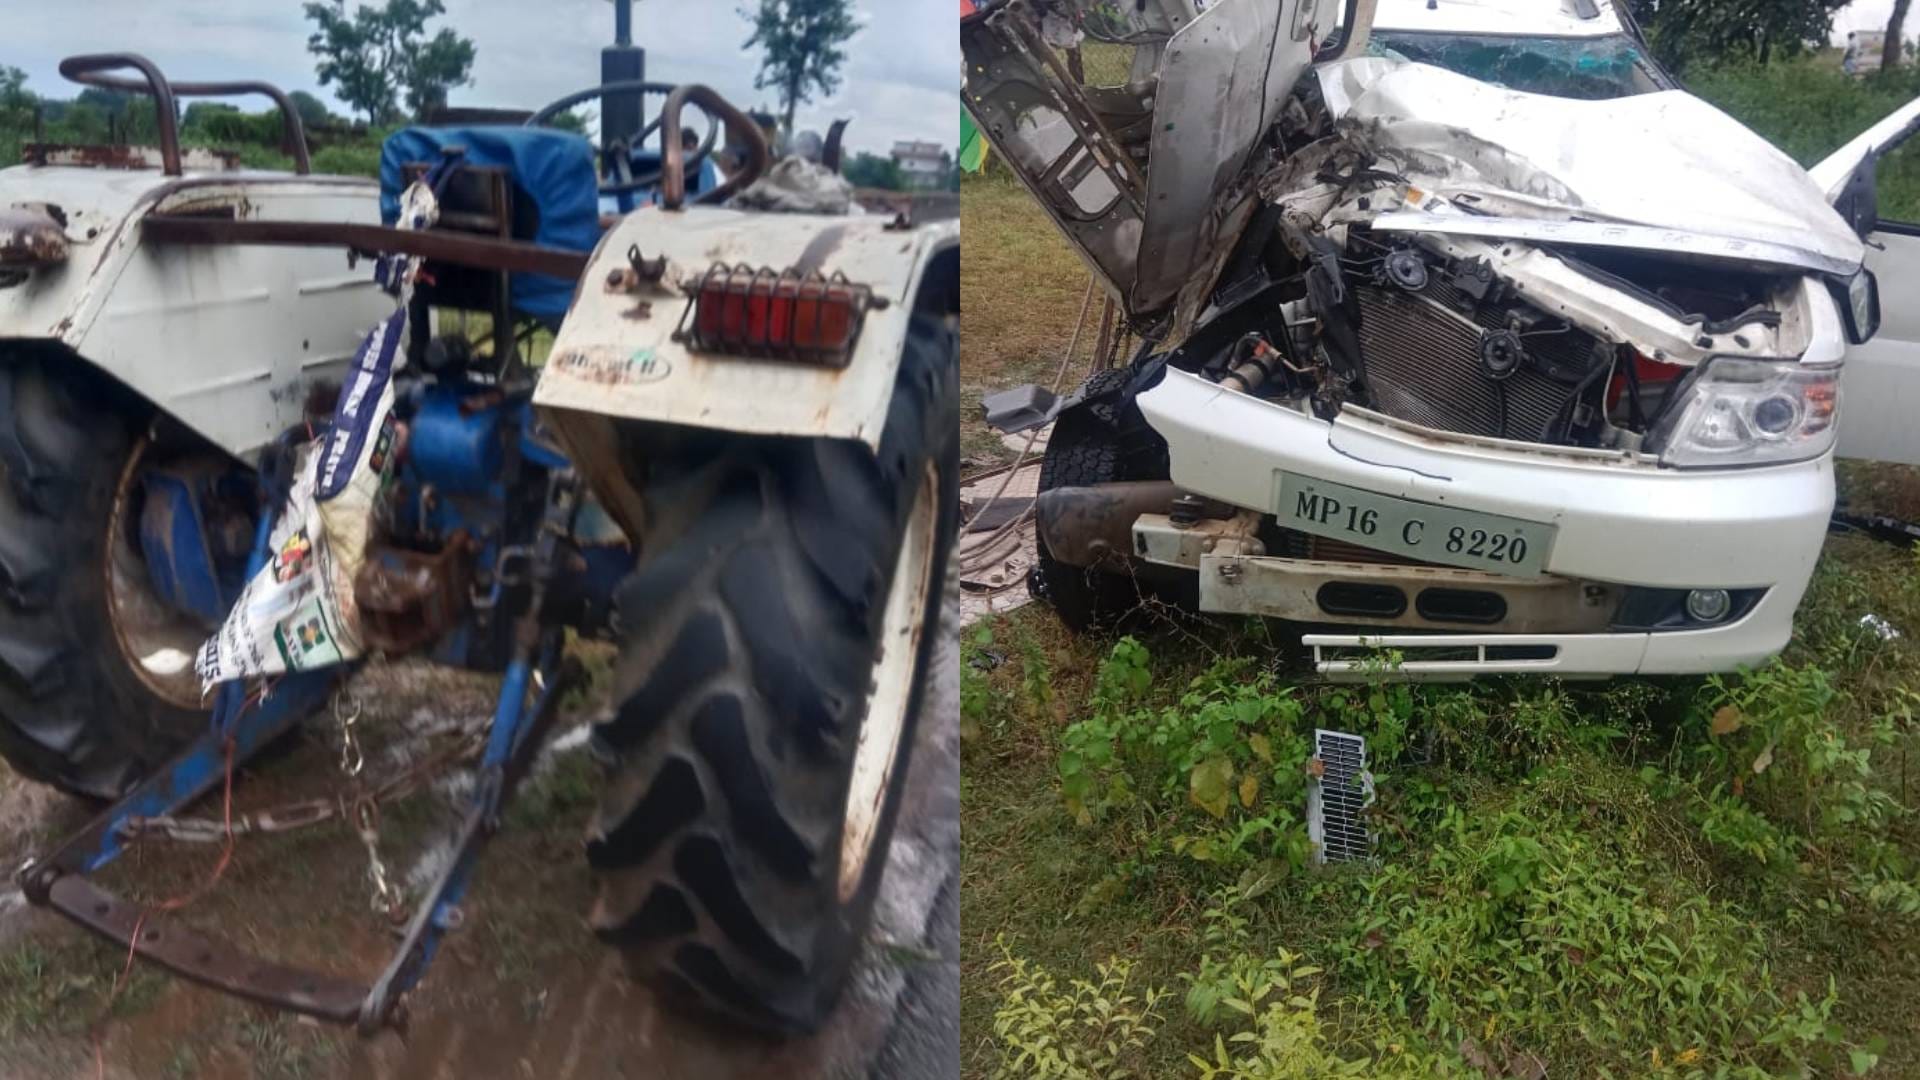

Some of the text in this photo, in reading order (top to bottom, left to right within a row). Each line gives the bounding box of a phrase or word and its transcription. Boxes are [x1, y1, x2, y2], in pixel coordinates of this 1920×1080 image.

[1296, 491, 1527, 563] MP16 C 8220
